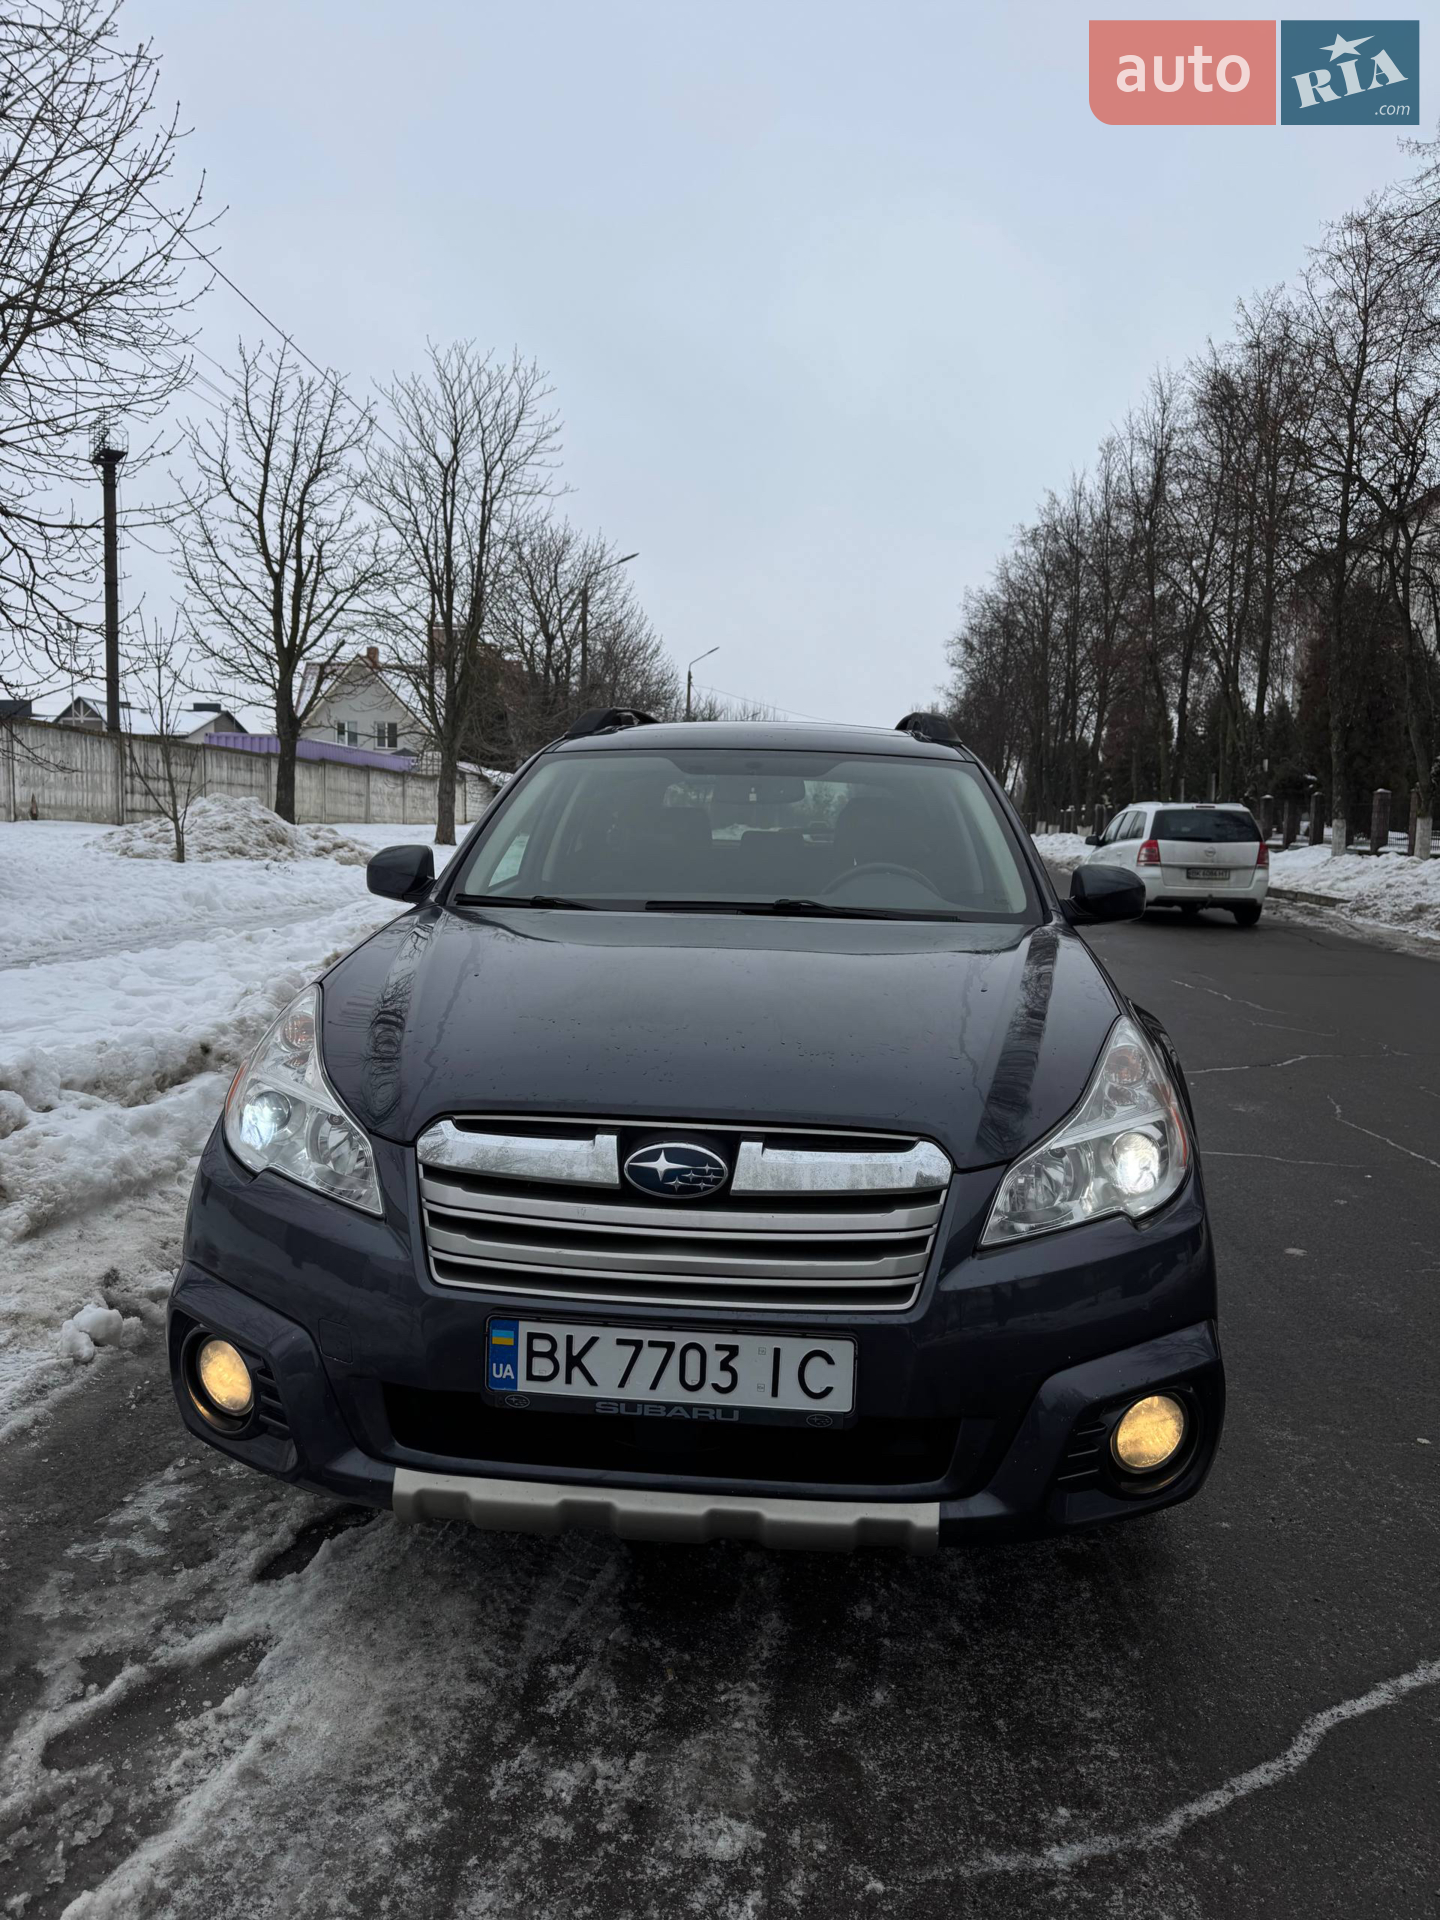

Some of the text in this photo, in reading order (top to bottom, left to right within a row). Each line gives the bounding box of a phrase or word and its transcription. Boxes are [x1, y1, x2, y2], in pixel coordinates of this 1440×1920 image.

[492, 1363, 515, 1379] UA
[526, 1331, 836, 1400] BK 7703 IC
[595, 1401, 740, 1422] SUBARU
